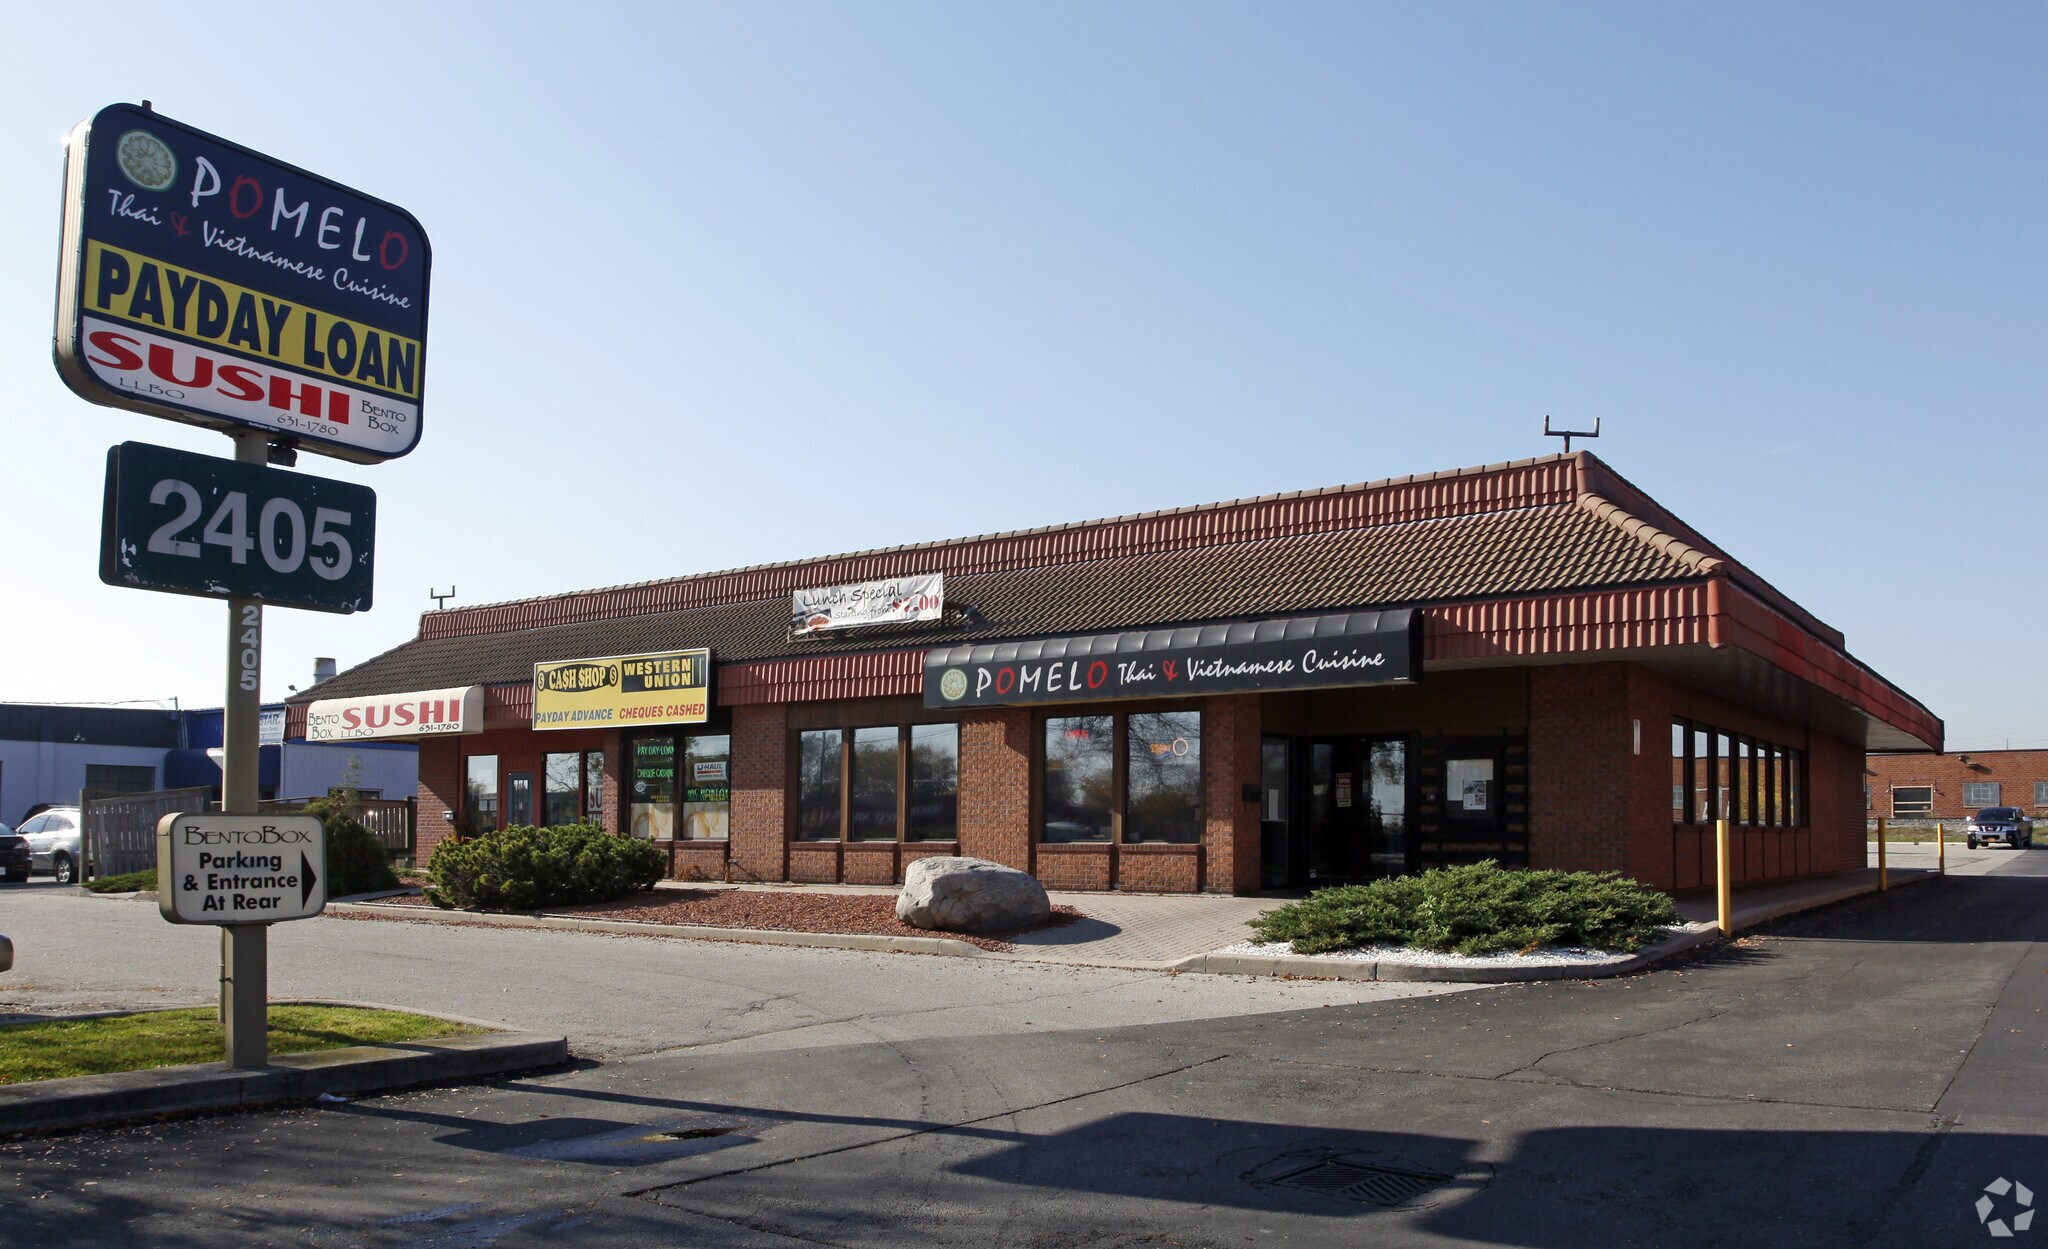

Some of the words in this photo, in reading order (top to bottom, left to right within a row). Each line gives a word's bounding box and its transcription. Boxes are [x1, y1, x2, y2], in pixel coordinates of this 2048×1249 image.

[191, 155, 408, 270] POMELO
[108, 188, 162, 226] Thai
[171, 211, 190, 237] &
[203, 221, 326, 281] Vietnamese
[333, 267, 411, 309] Cuisine
[97, 247, 292, 358] PAYDAY
[304, 313, 416, 395] LOAN
[87, 330, 350, 425] SUSHI
[119, 376, 185, 400] LLBO
[277, 413, 339, 436] 631-1780
[147, 478, 352, 580] 2405
[803, 590, 847, 607] Lunch
[850, 582, 902, 605] Special
[239, 604, 259, 691] 2405
[624, 658, 691, 676] WESTERN
[976, 660, 1108, 698] POMELO
[1118, 660, 1157, 686] Thai
[1162, 659, 1179, 682] &
[1187, 656, 1295, 682] Vietnamese
[1302, 649, 1386, 674] Cuisine
[644, 672, 691, 689] UNION
[341, 699, 461, 730] SUSHI
[535, 711, 570, 723] PAYDAY
[570, 708, 613, 722] ADVANCE
[619, 705, 664, 719] CHEQUES
[666, 703, 705, 716] CASHED
[341, 728, 374, 738] LLBO
[418, 723, 459, 732] 631-1780
[199, 850, 282, 872] Parking
[183, 874, 199, 891] &
[207, 873, 298, 891] Entrance
[202, 894, 226, 912] At
[233, 893, 282, 910] Rear
